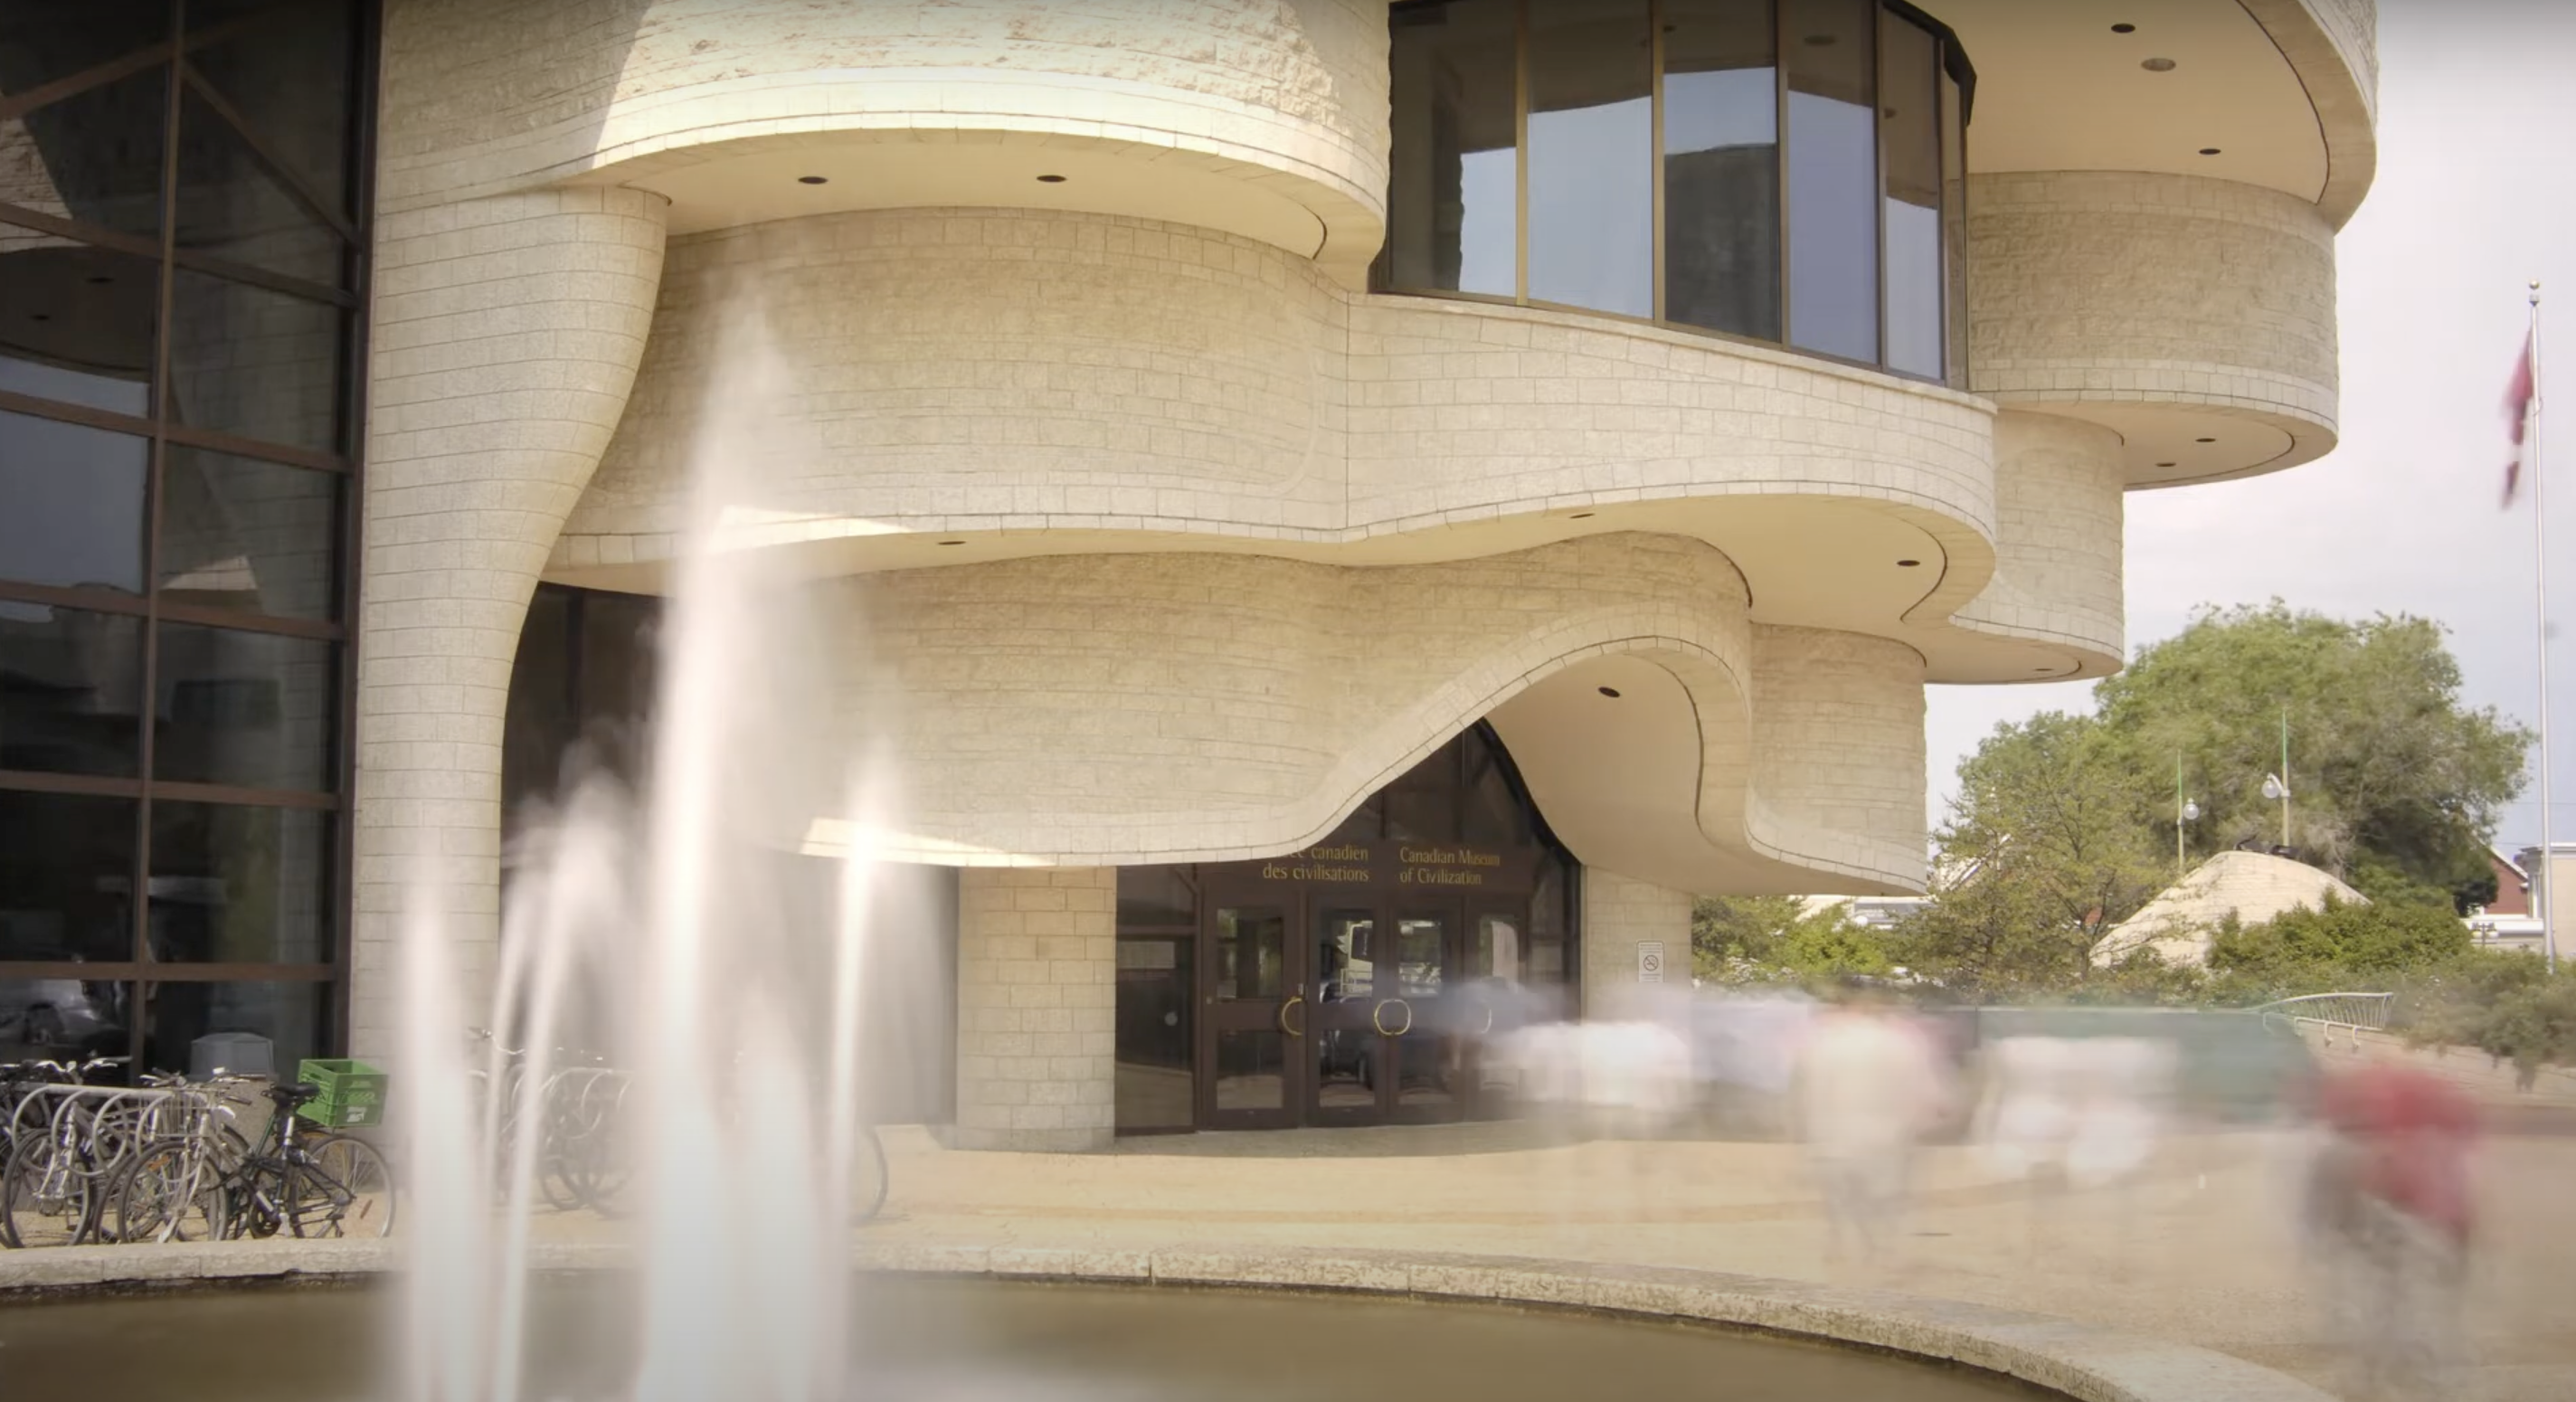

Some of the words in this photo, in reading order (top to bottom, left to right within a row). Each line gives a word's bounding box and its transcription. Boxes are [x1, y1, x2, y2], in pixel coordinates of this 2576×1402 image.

[1311, 845, 1368, 861] canadien
[1400, 847, 1454, 864] Canadian
[1458, 849, 1500, 866] Museum
[1263, 862, 1287, 879] des
[1293, 864, 1368, 881] civilisations
[1399, 867, 1415, 883] of
[1417, 867, 1482, 885] Civilization
